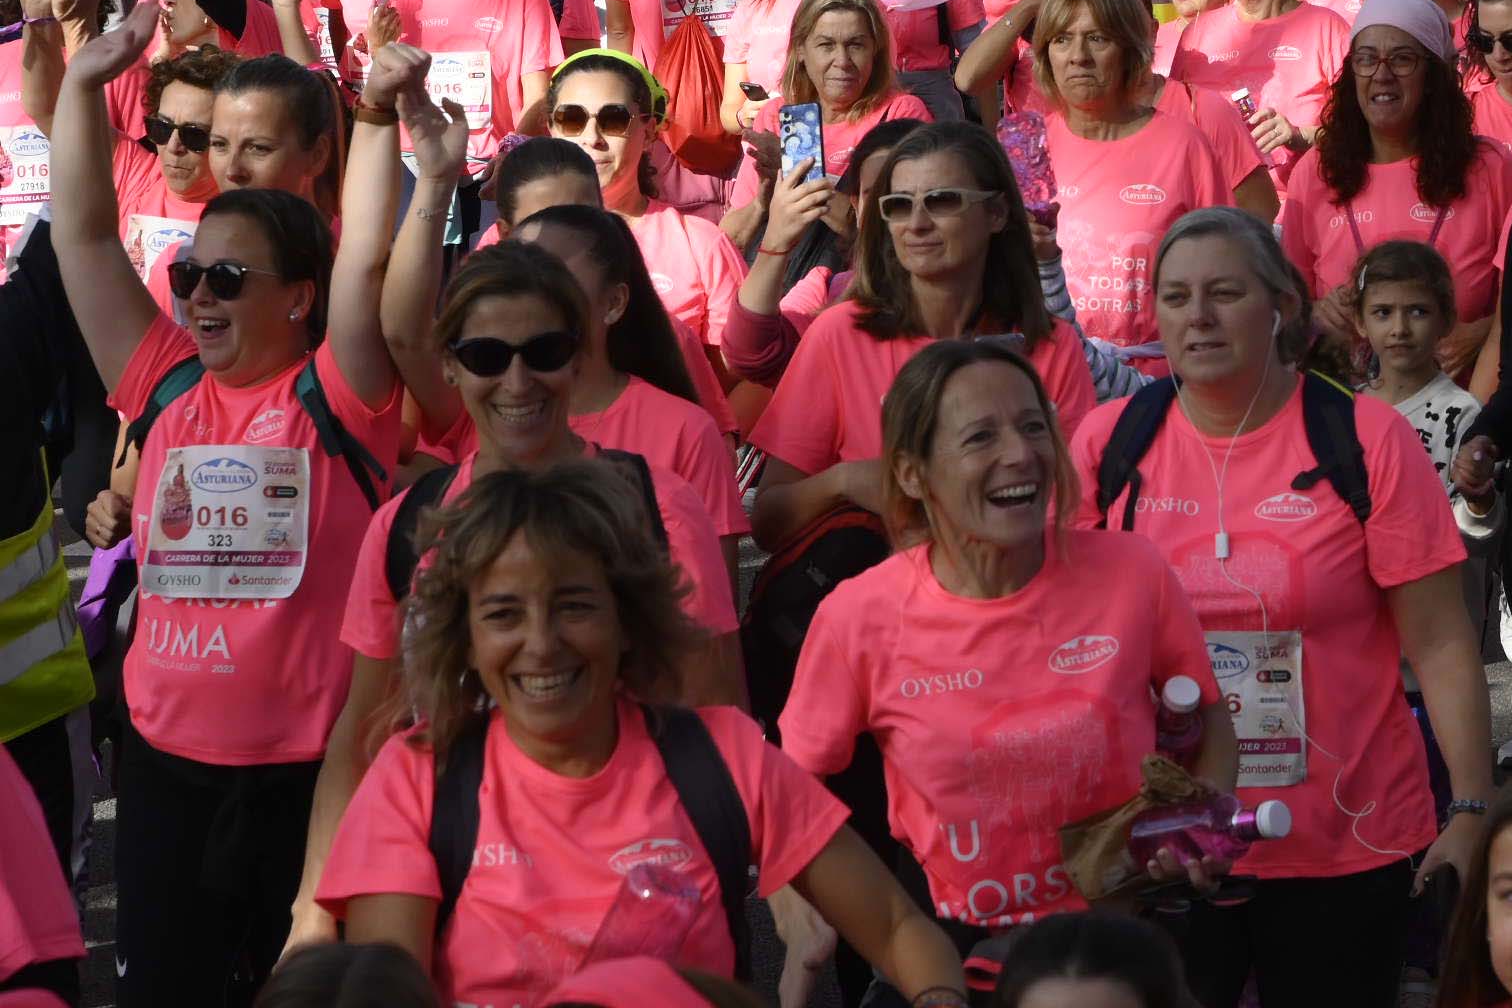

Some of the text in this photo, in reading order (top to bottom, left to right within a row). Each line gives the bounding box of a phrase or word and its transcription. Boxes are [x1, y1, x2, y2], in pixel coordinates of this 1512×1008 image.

[17, 163, 49, 178] 016
[1112, 257, 1147, 271] POR
[195, 471, 252, 485] ASTURIANA
[1135, 496, 1200, 516] OYSHO
[197, 506, 248, 527] 016
[207, 534, 233, 547] 323
[165, 554, 202, 563] CARRERA
[203, 554, 216, 563] DE
[217, 554, 230, 563] LA
[232, 554, 265, 563] MUJER
[158, 574, 201, 586] OYSHO
[242, 574, 293, 586] Santander
[1055, 643, 1114, 670] ASTURIANA
[901, 668, 984, 698] OYSHO
